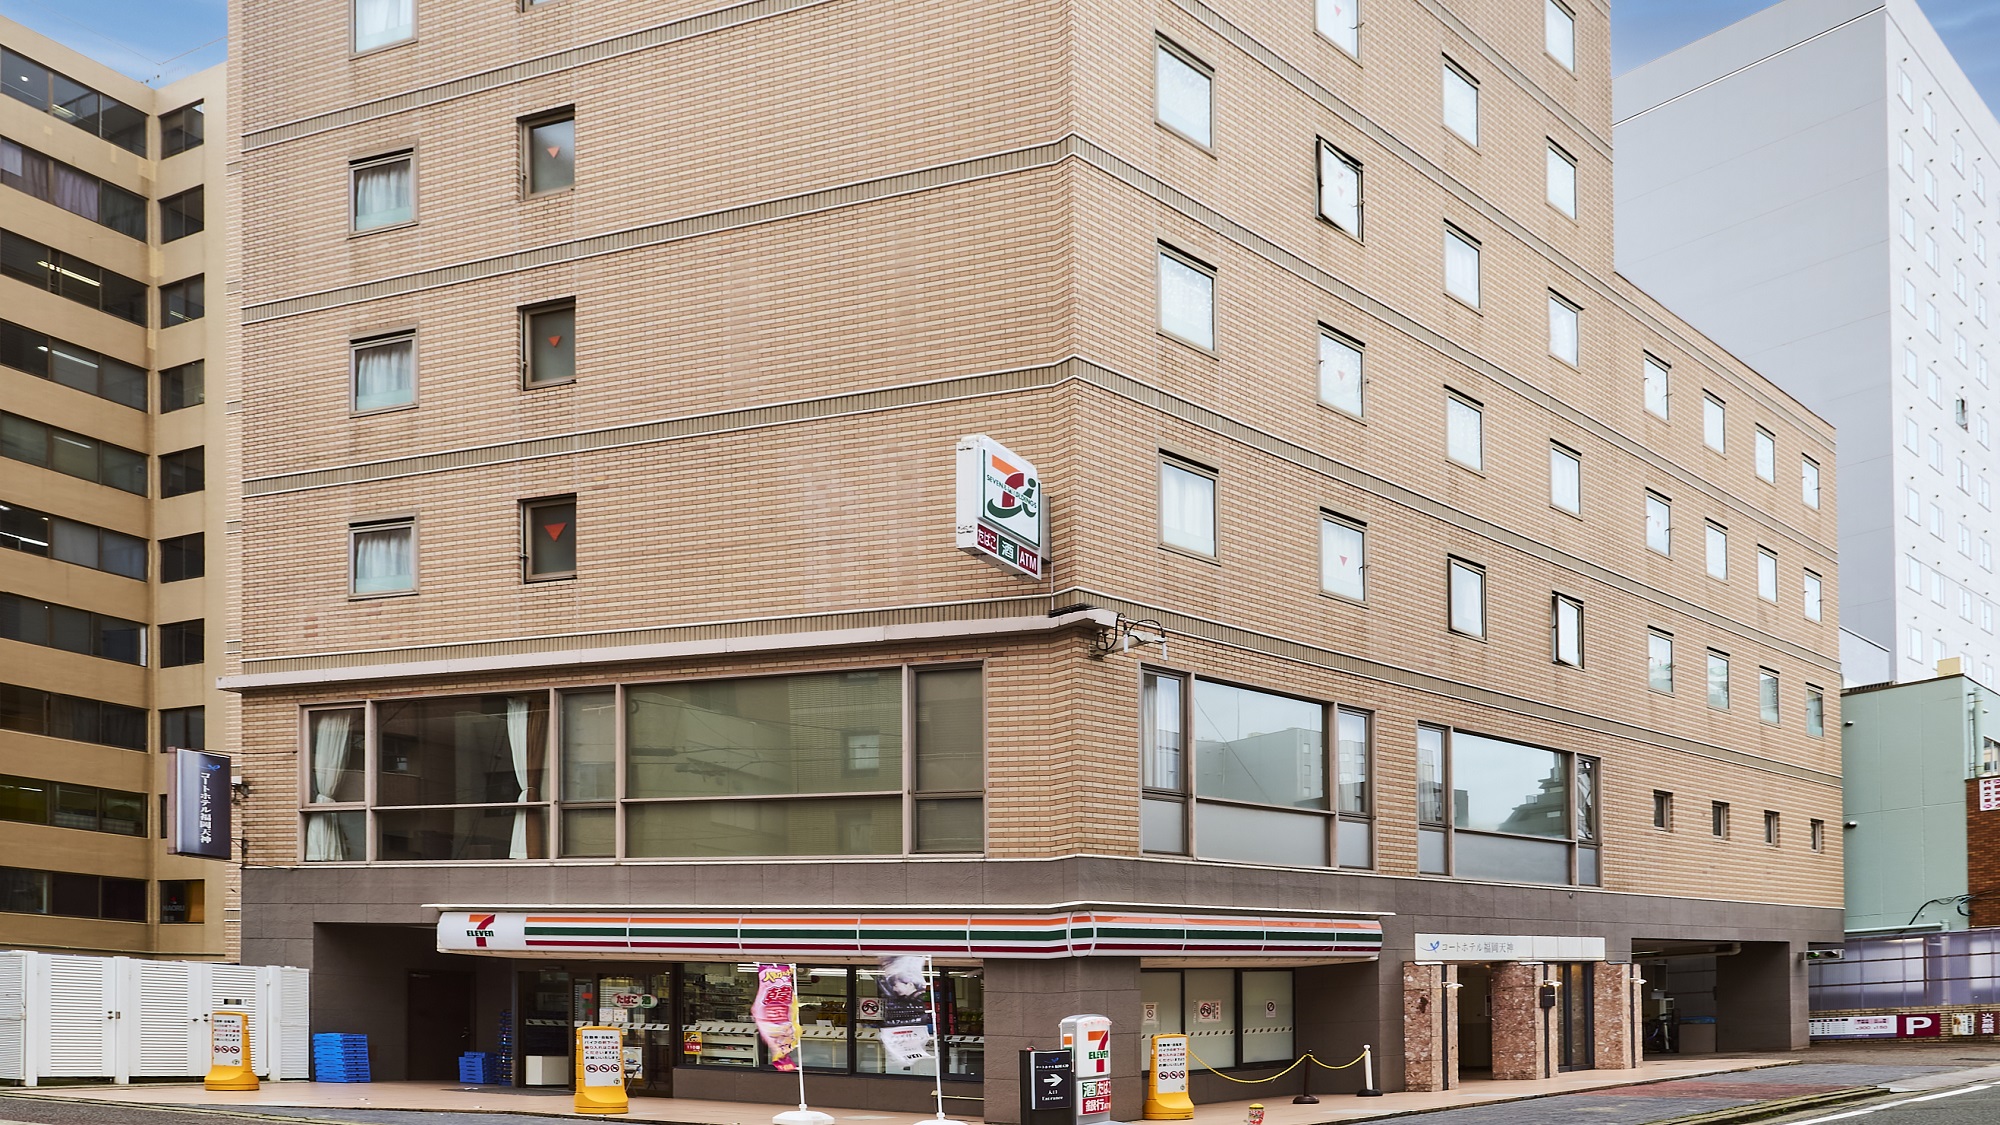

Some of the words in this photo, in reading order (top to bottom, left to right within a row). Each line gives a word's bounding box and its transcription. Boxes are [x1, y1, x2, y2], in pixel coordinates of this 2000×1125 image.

[977, 528, 997, 550] たばこ
[1001, 541, 1015, 560] 酒
[1019, 551, 1037, 571] ATM
[200, 772, 212, 844] コートホテル福岡天神
[1442, 942, 1514, 954] コートホテル福岡天神
[616, 995, 638, 1005] たばこ
[1905, 1016, 1933, 1035] P
[1083, 1082, 1097, 1098] 酒
